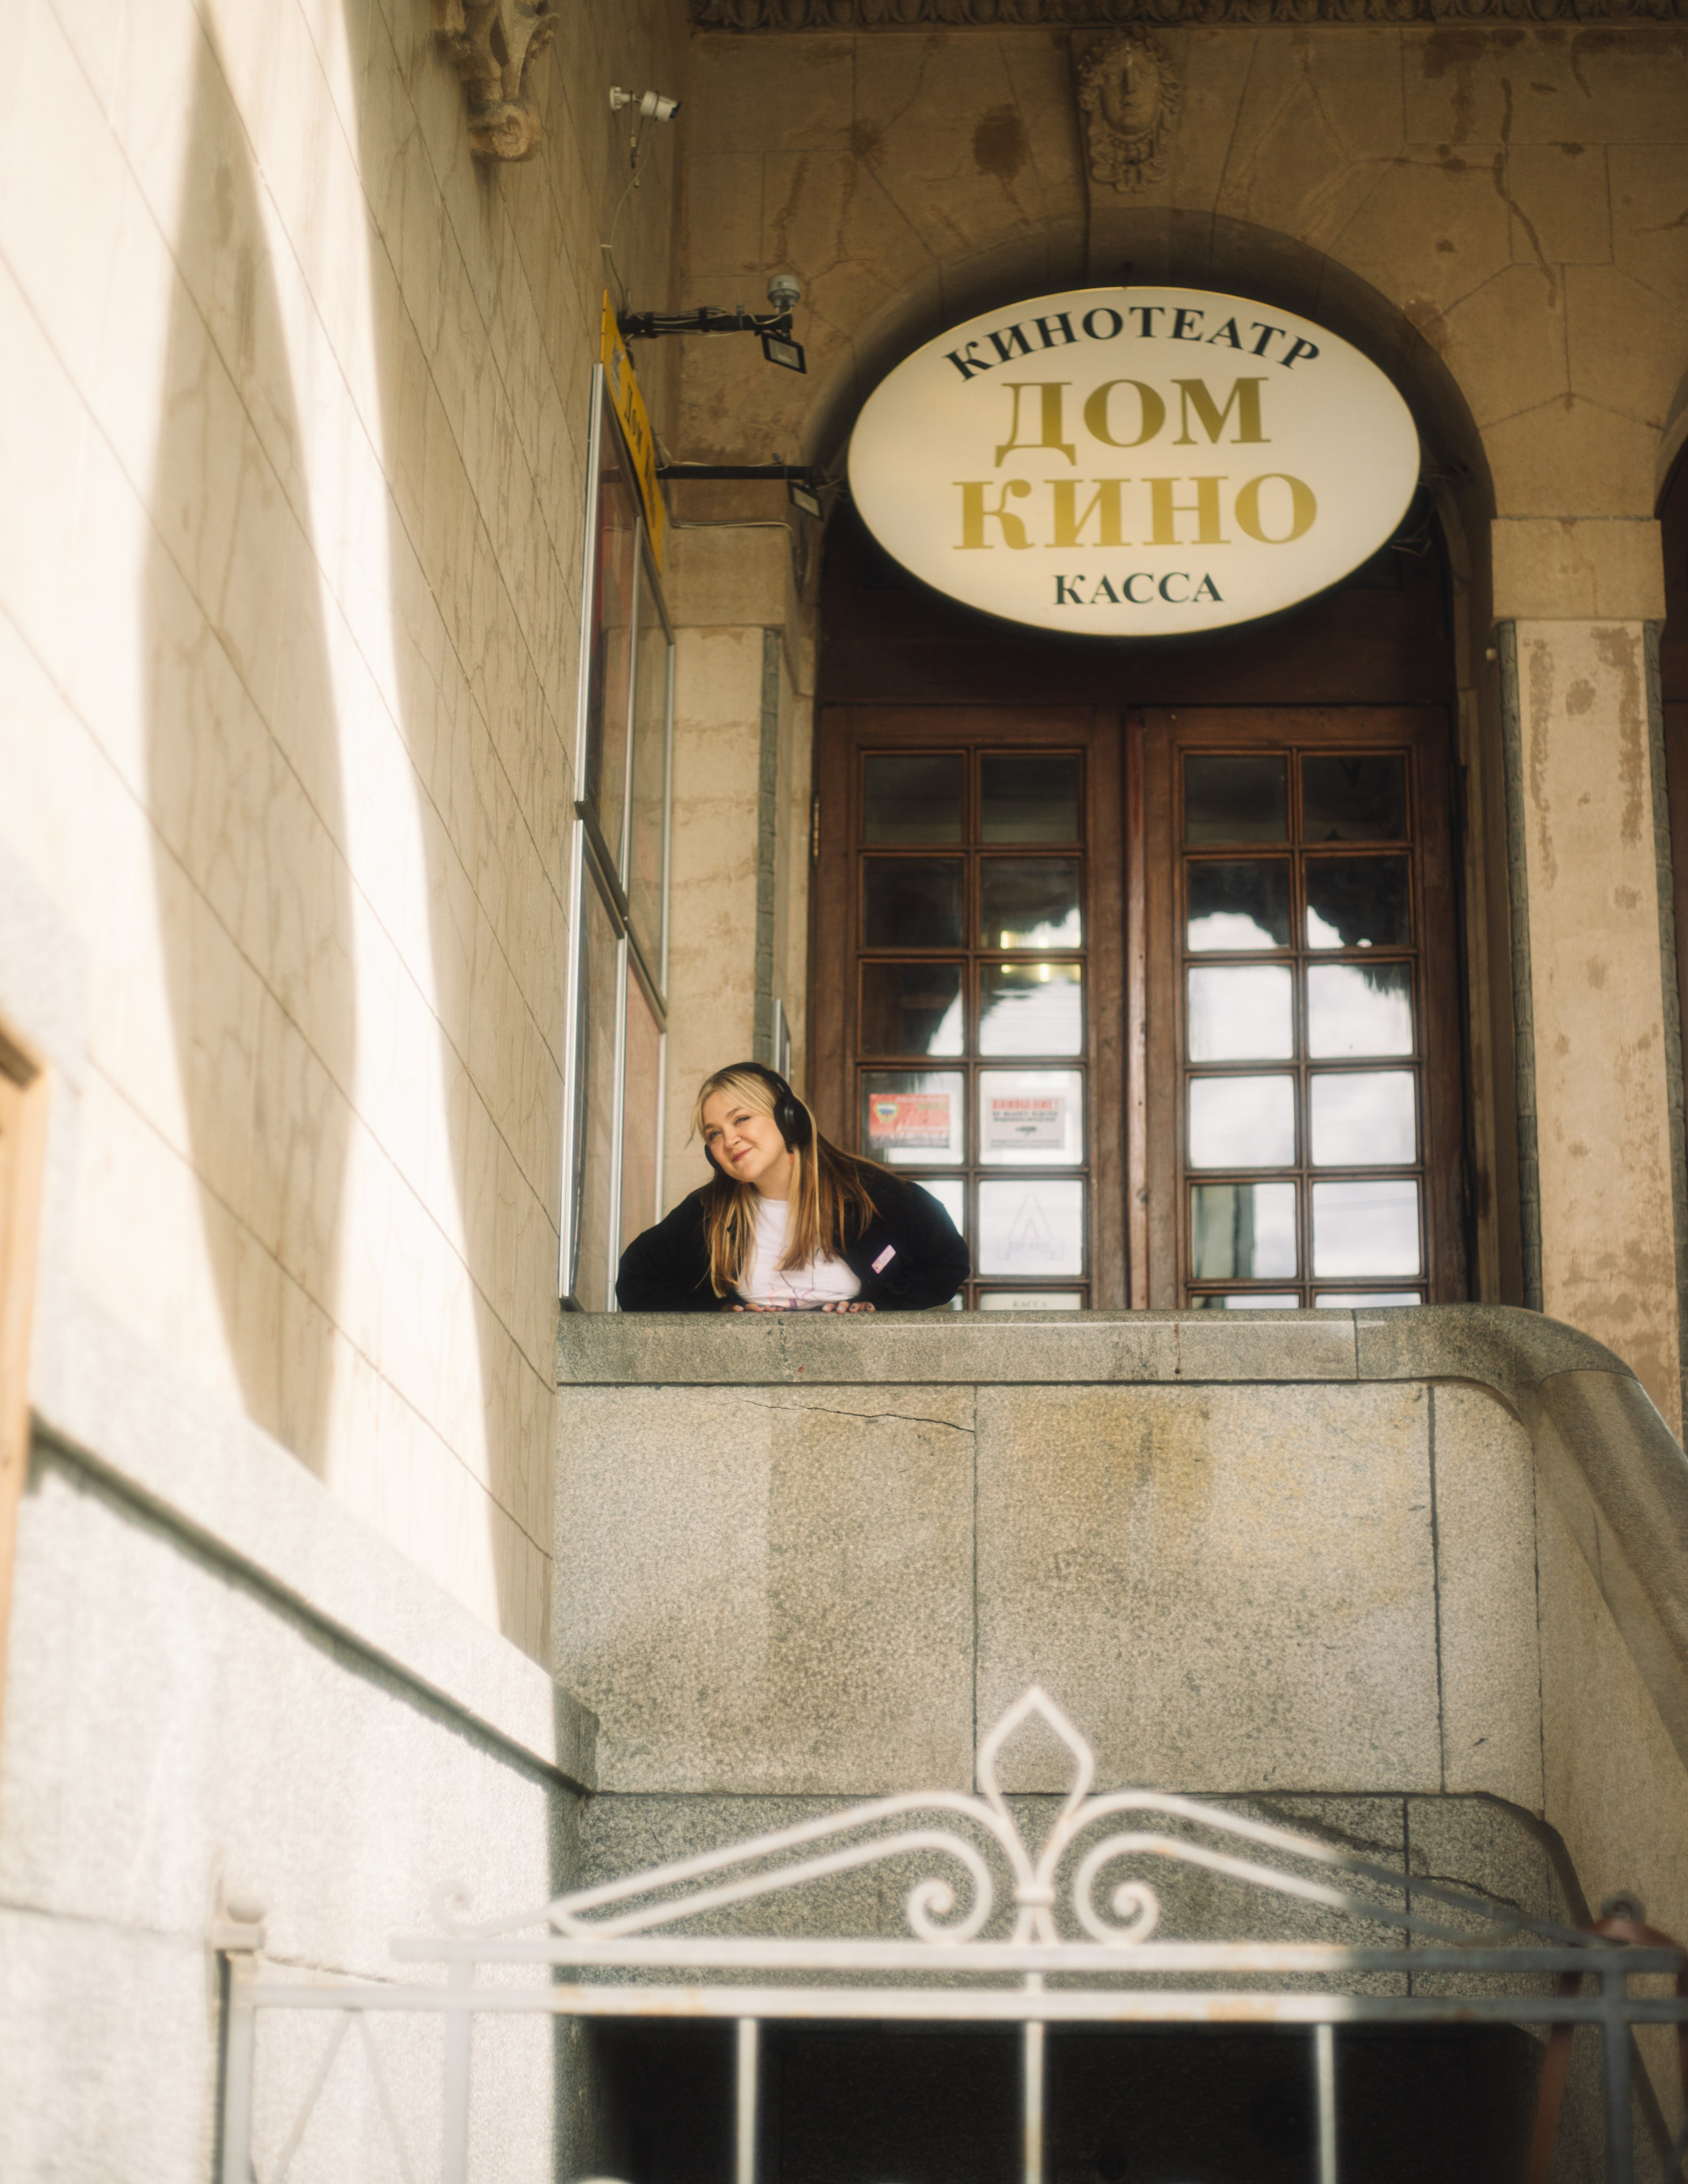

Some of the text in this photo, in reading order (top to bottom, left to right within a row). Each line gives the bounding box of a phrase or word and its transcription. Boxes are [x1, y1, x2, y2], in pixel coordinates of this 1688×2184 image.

[942, 307, 1320, 382] КИНОТЕАТР
[994, 376, 1272, 467] ДОМ
[951, 473, 1317, 550] КИНО
[1052, 572, 1224, 605] КАССА
